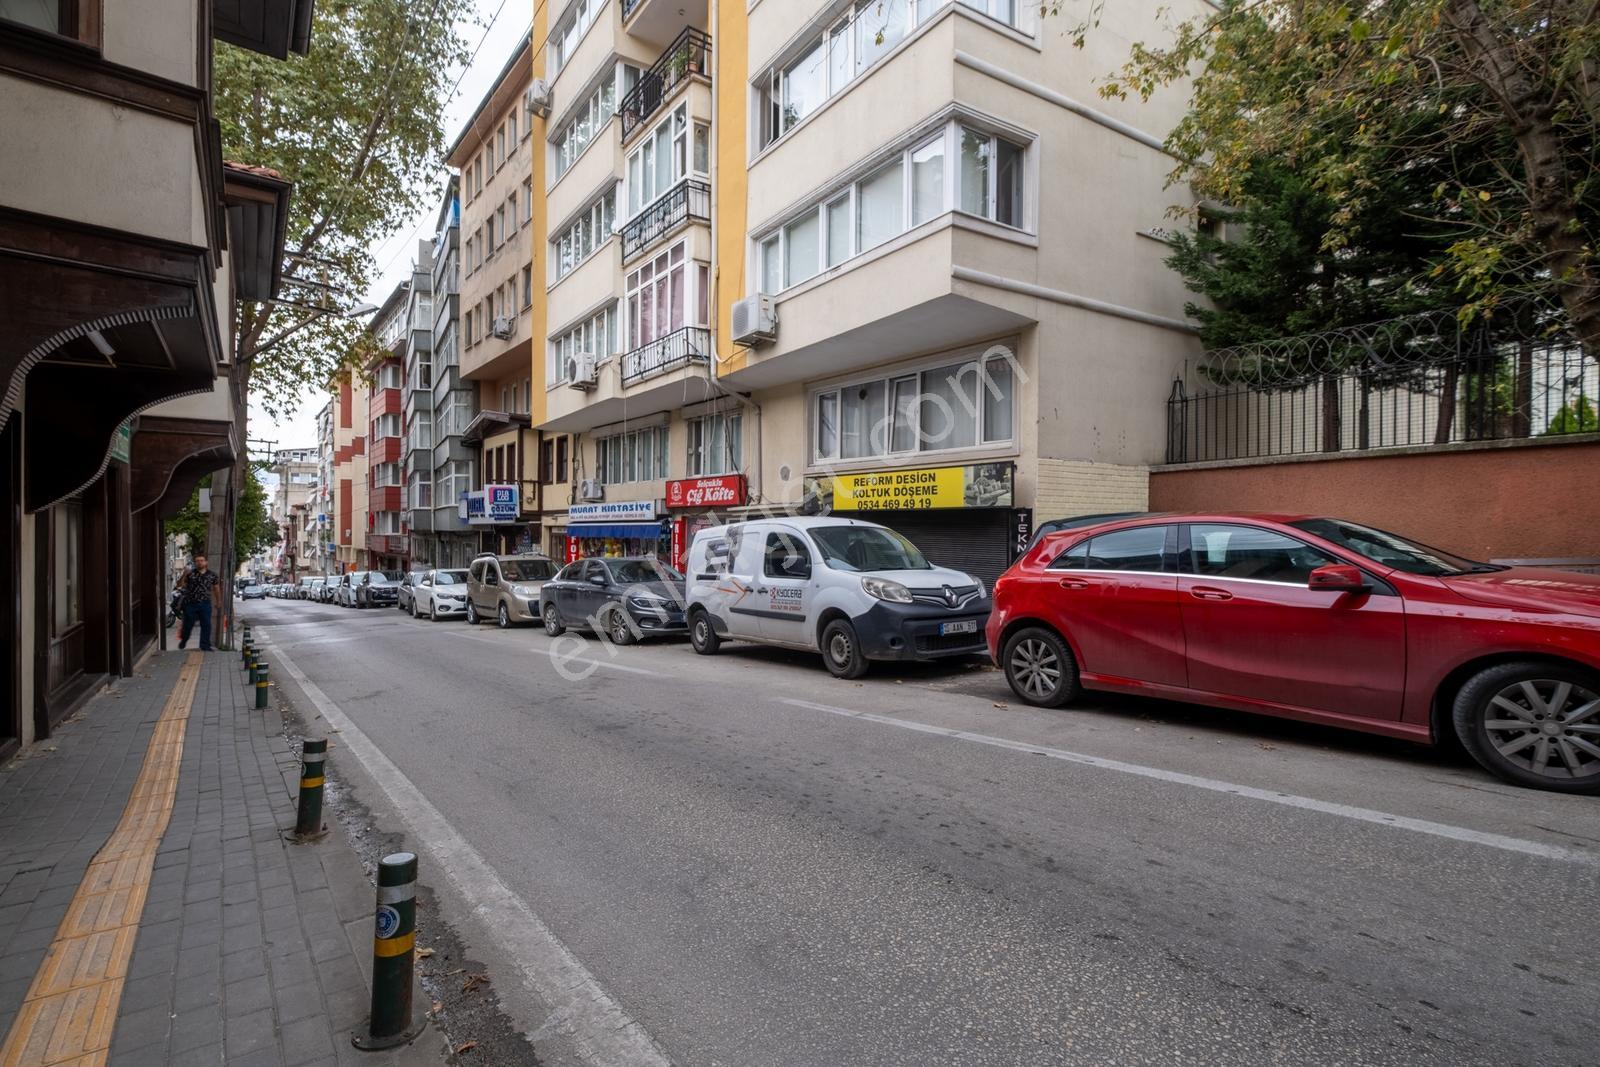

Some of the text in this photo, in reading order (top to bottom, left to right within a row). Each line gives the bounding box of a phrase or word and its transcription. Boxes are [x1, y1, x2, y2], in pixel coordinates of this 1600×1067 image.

[854, 472, 936, 487] REFORM DESİGN
[686, 487, 735, 506] Çiğ Köfte
[853, 485, 938, 498] KOLTUK DÖŞEME
[570, 502, 652, 514] MURAT KIRTASİYE
[857, 498, 932, 510] 0534 469 49 19
